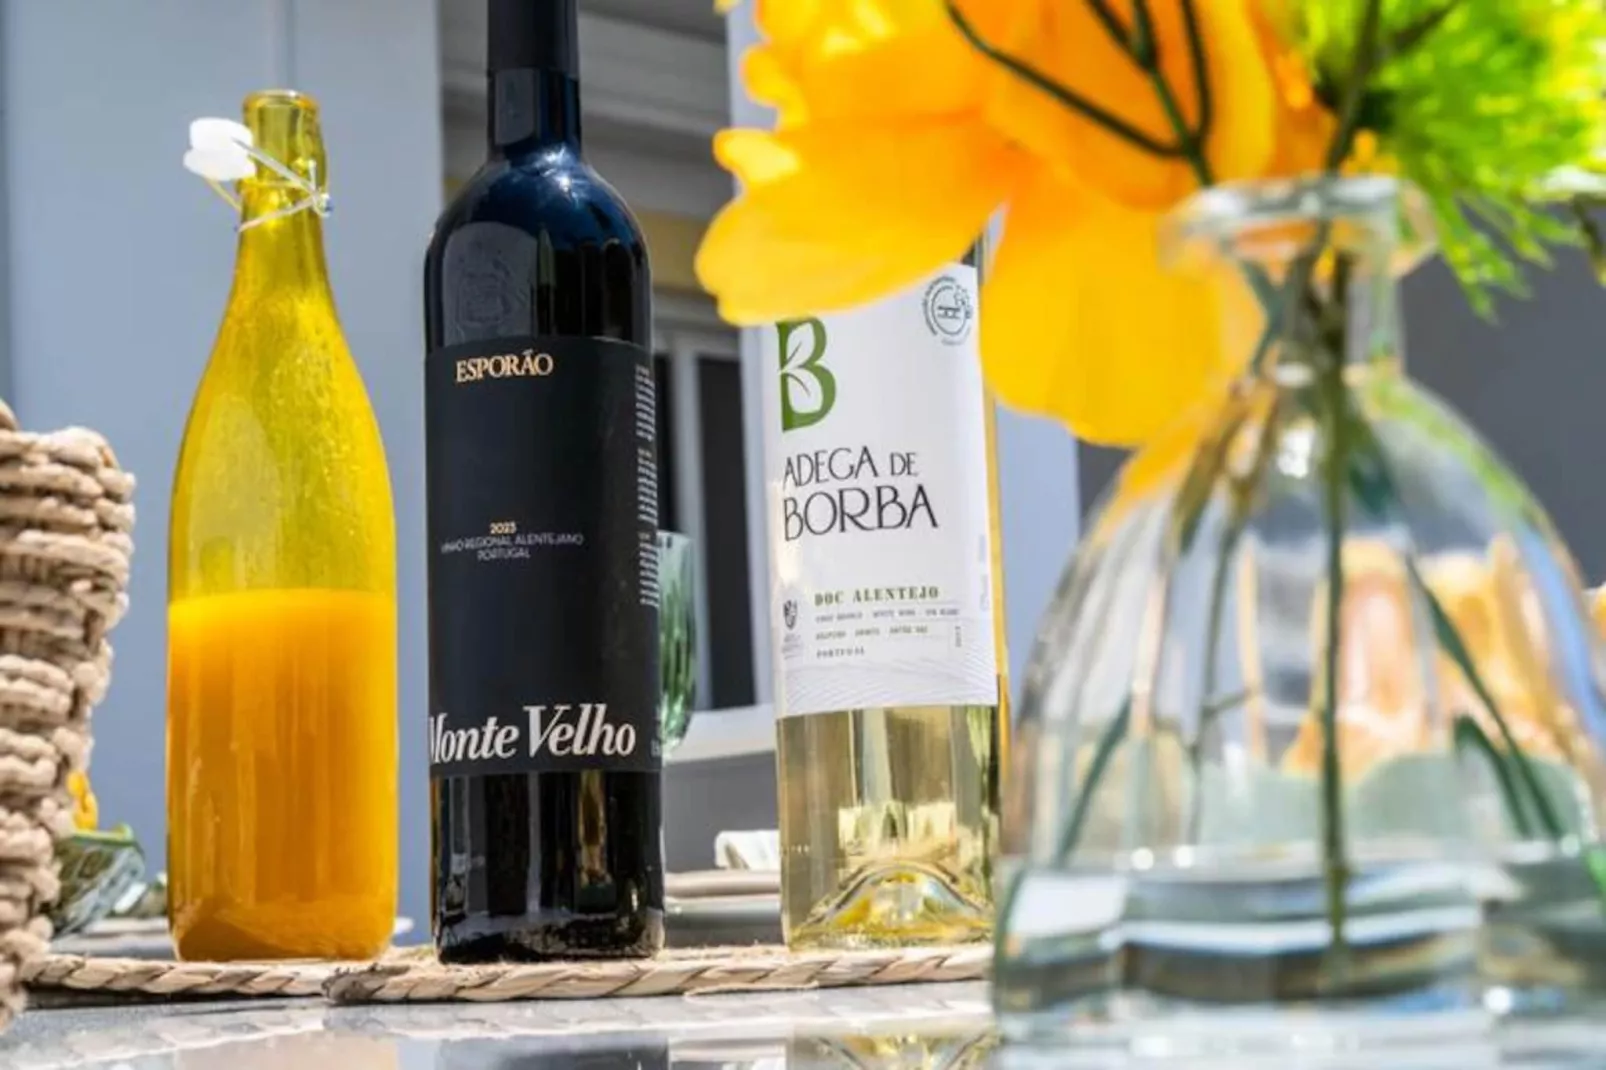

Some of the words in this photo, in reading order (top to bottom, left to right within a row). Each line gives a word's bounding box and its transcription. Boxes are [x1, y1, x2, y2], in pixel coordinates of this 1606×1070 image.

[456, 349, 554, 383] ESPORÃO
[782, 445, 880, 490] ADEGA
[890, 451, 919, 477] DE
[783, 484, 939, 541] BORBA
[814, 591, 845, 606] DOC
[852, 586, 939, 603] ALENTEJO
[522, 703, 637, 758] Velho
